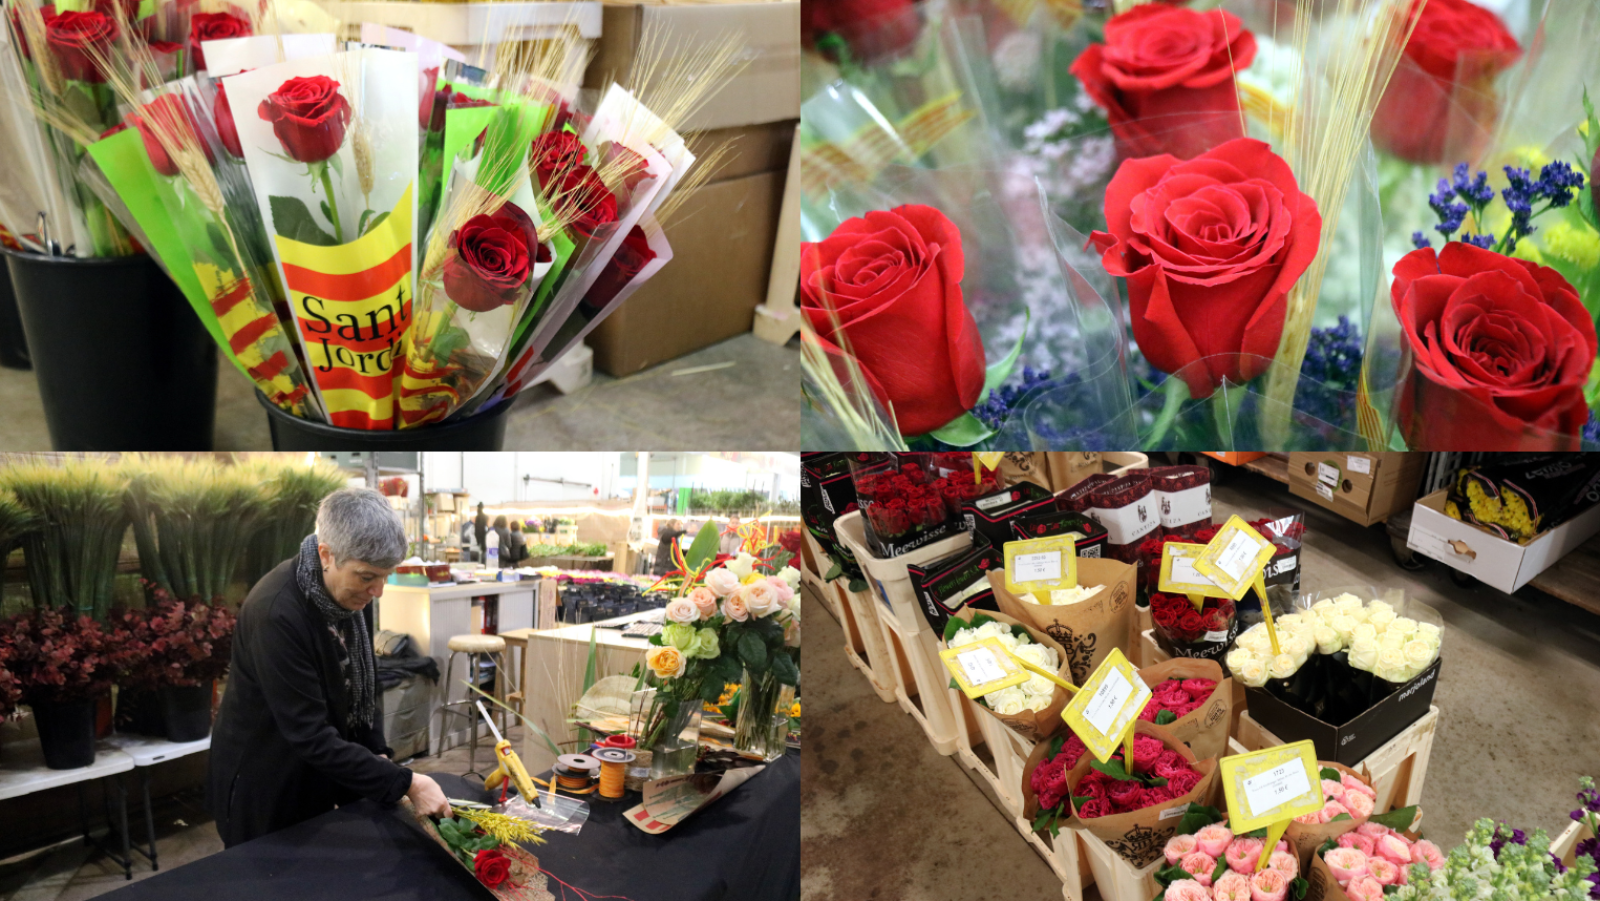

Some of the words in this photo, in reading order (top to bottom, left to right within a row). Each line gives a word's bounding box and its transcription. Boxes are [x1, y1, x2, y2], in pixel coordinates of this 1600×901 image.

[302, 285, 408, 342] Sant
[880, 525, 947, 558] Meewisse
[1398, 668, 1436, 702] marjoland
